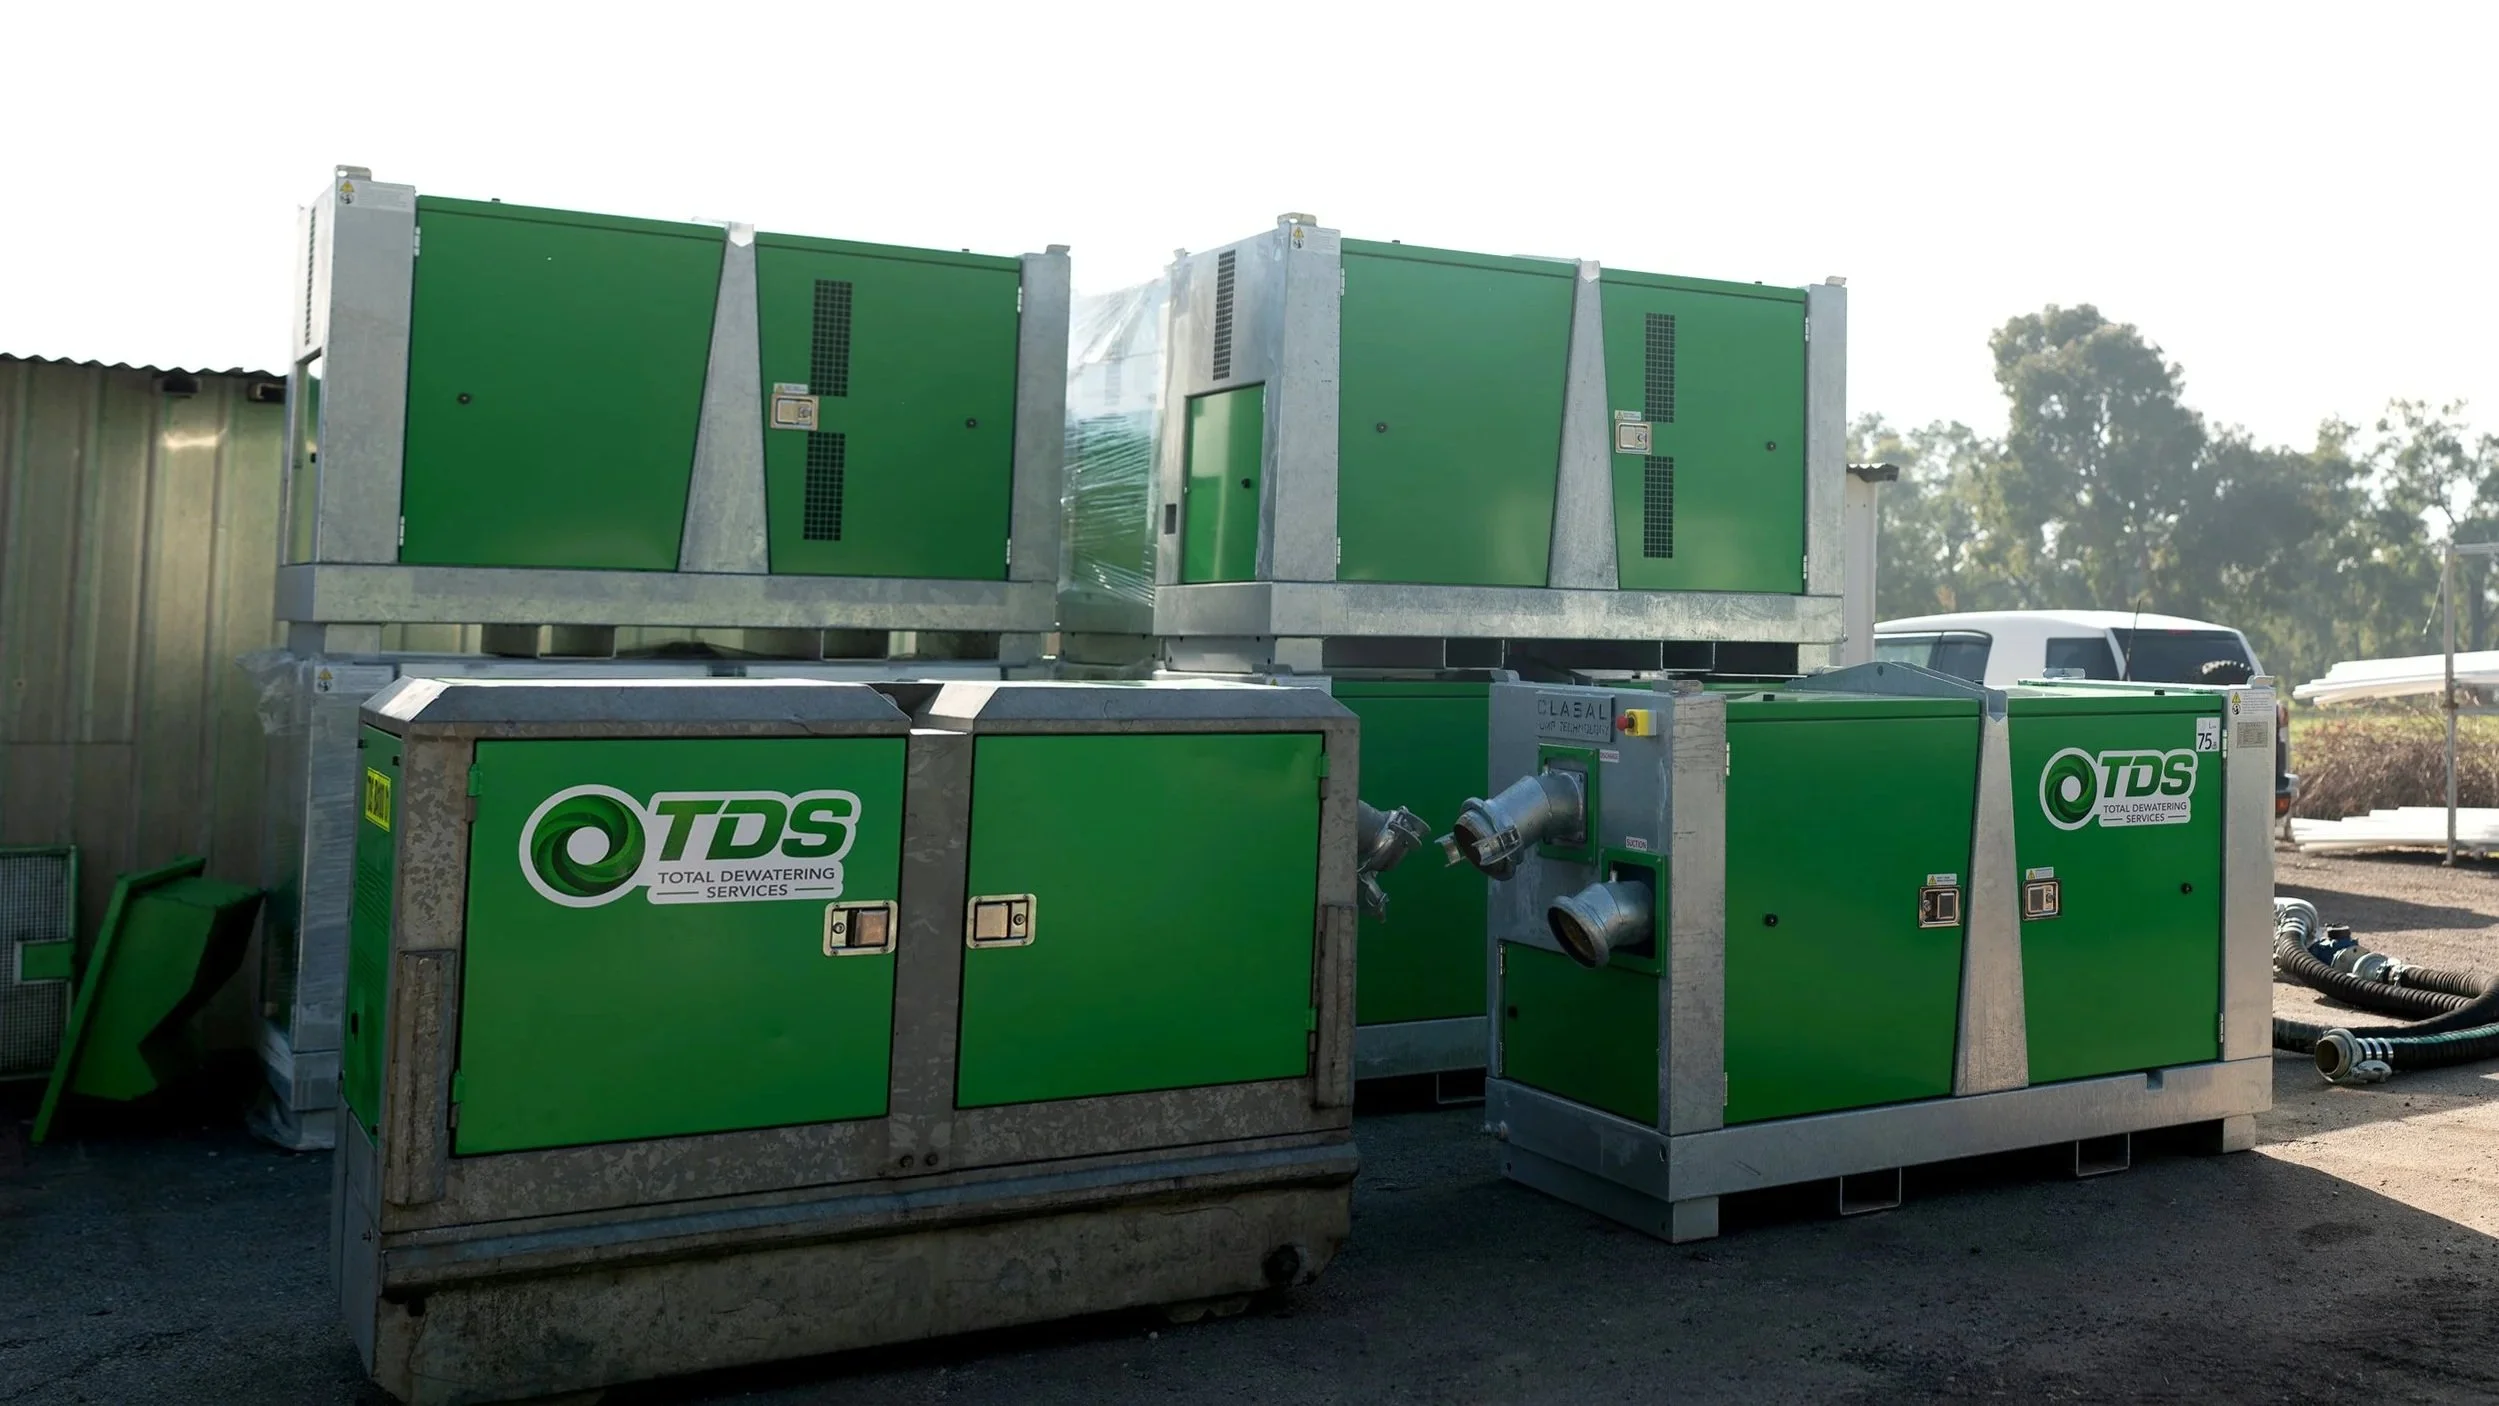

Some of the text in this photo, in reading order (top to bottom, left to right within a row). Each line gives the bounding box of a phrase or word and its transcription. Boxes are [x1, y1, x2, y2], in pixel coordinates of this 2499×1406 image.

[2198, 732, 2212, 750] 75
[2101, 754, 2194, 798] TDS
[2103, 801, 2187, 813] TOTAL DEWATERING
[2126, 812, 2165, 824] SERVICES
[655, 797, 852, 861] TDS
[1626, 838, 1646, 848] SUCTION
[657, 867, 835, 885] TOTAL DEWATERING
[707, 884, 788, 899] SERVICES
